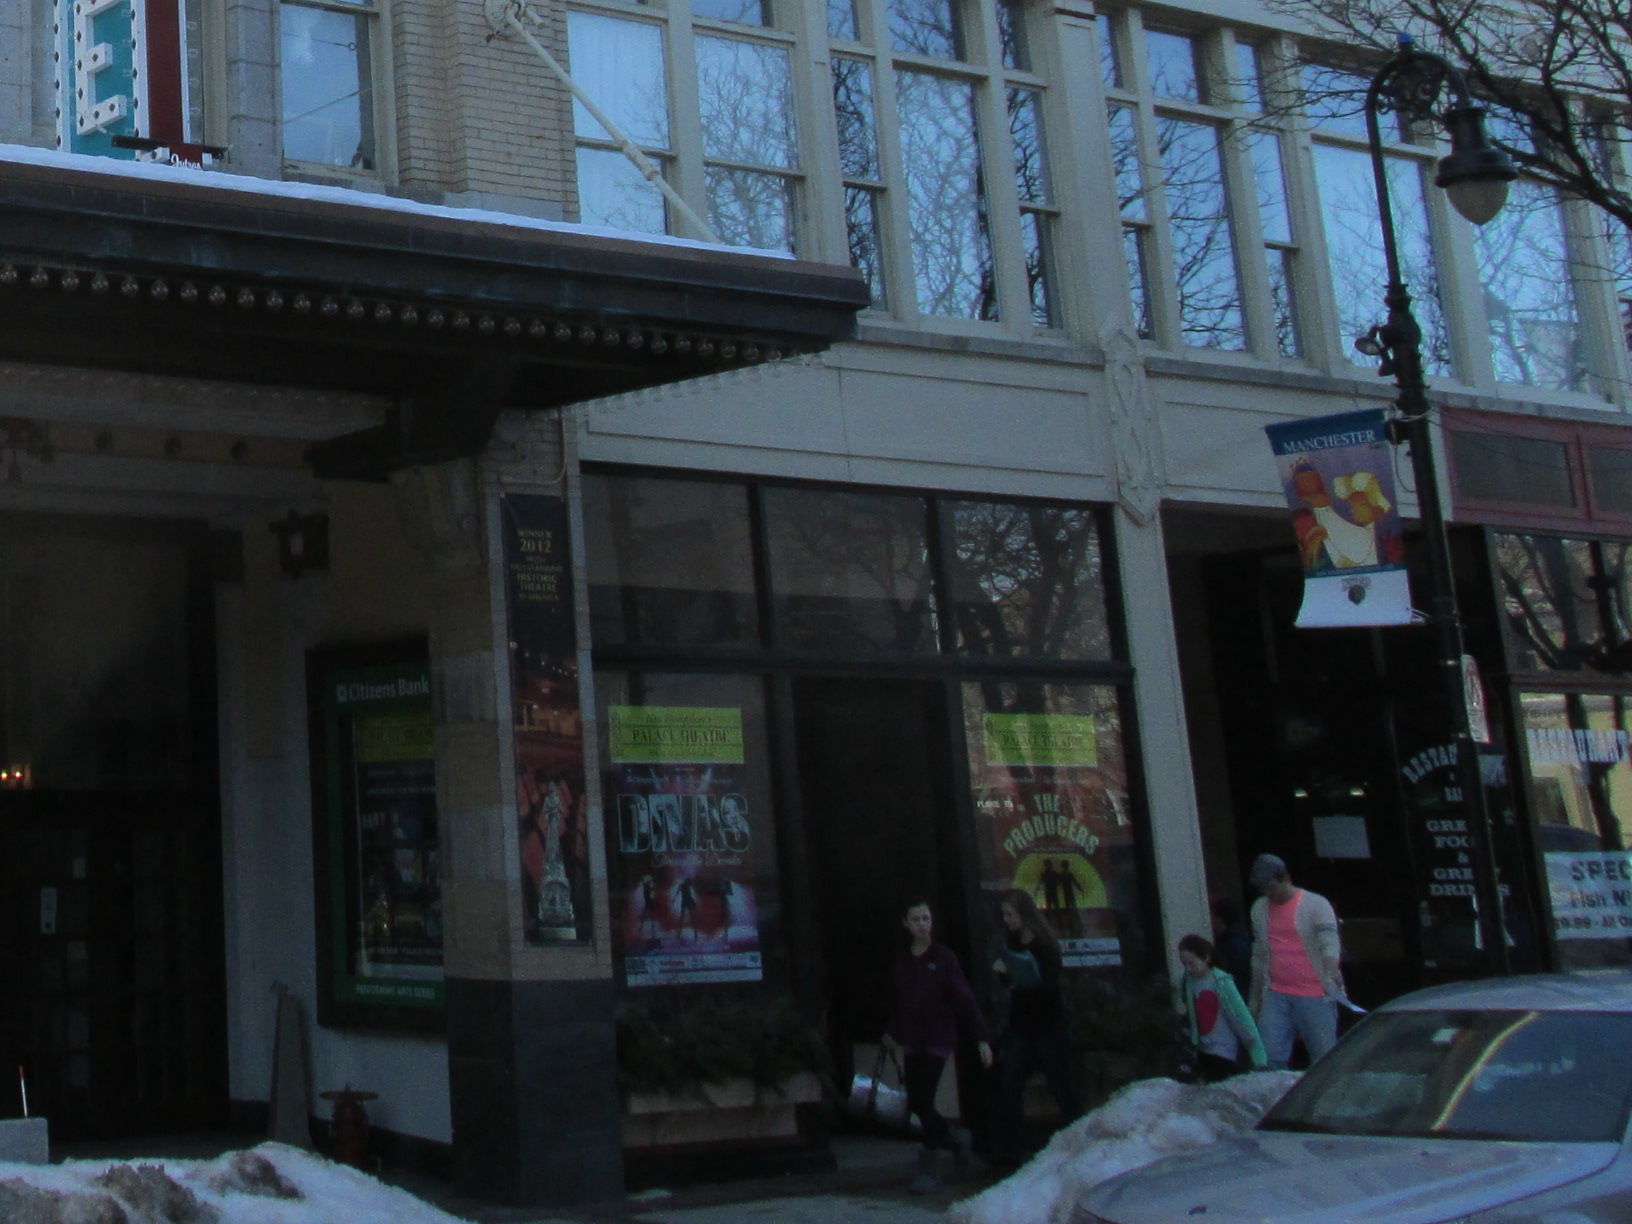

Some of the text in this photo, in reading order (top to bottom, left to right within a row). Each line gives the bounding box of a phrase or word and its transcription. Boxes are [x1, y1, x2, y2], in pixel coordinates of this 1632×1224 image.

[1282, 429, 1377, 454] MANCHESTER
[517, 528, 553, 539] WINNER
[520, 538, 552, 554] 2012
[516, 573, 559, 583] HISTORIC
[519, 582, 558, 593] THEATRE
[348, 674, 430, 702] Citizens Bank
[1033, 793, 1062, 813] THE
[617, 792, 752, 854] DIVAS
[1425, 819, 1467, 833] GRE
[1002, 812, 1101, 858] PRODUCERS
[1433, 868, 1473, 880] GRE
[1571, 890, 1608, 908] Fish
